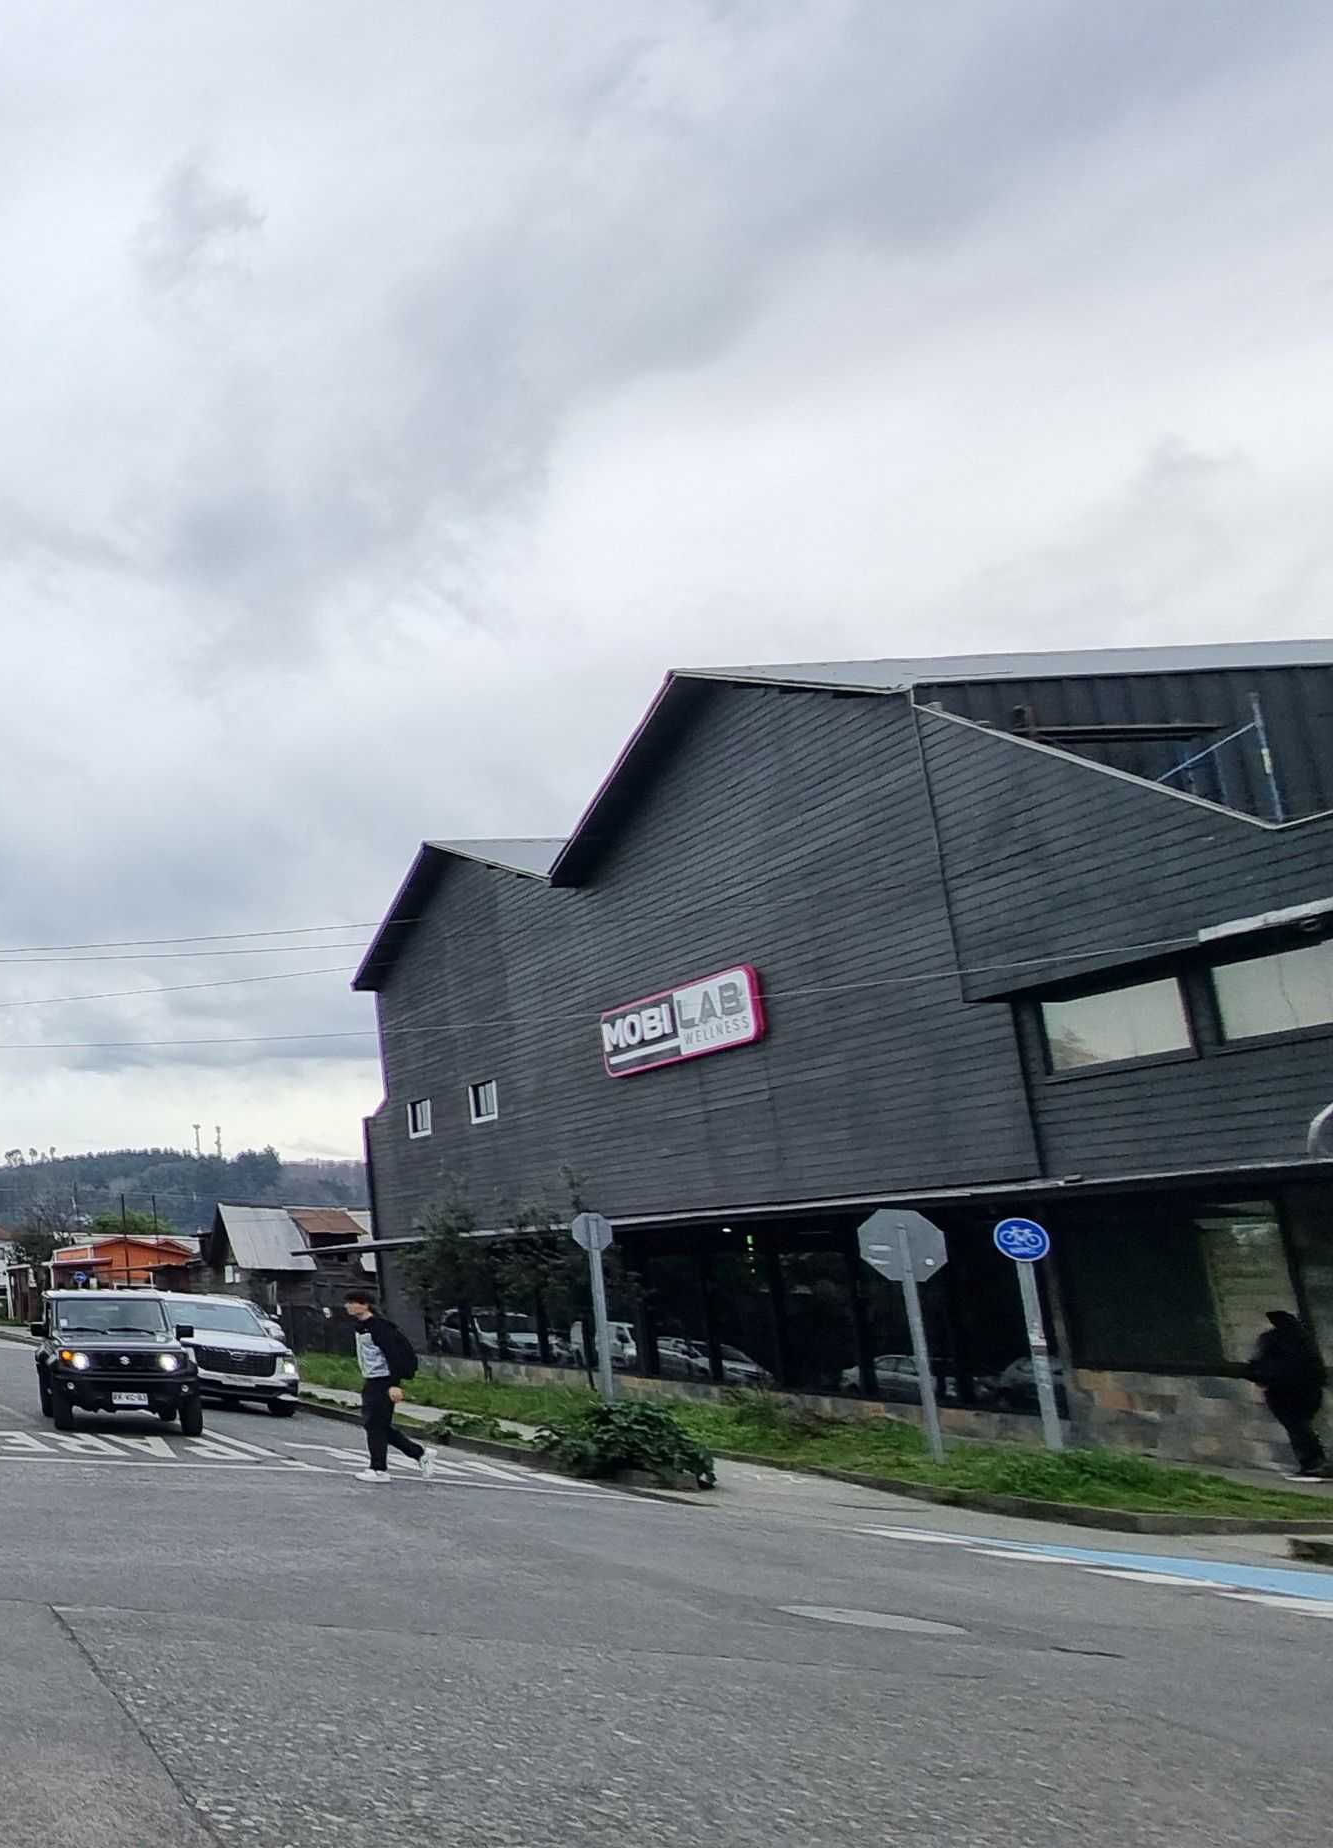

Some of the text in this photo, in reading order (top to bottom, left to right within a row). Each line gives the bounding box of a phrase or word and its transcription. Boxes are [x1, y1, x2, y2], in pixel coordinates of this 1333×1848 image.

[601, 982, 744, 1052] MOBI LAB
[684, 1015, 750, 1046] WELLNESS
